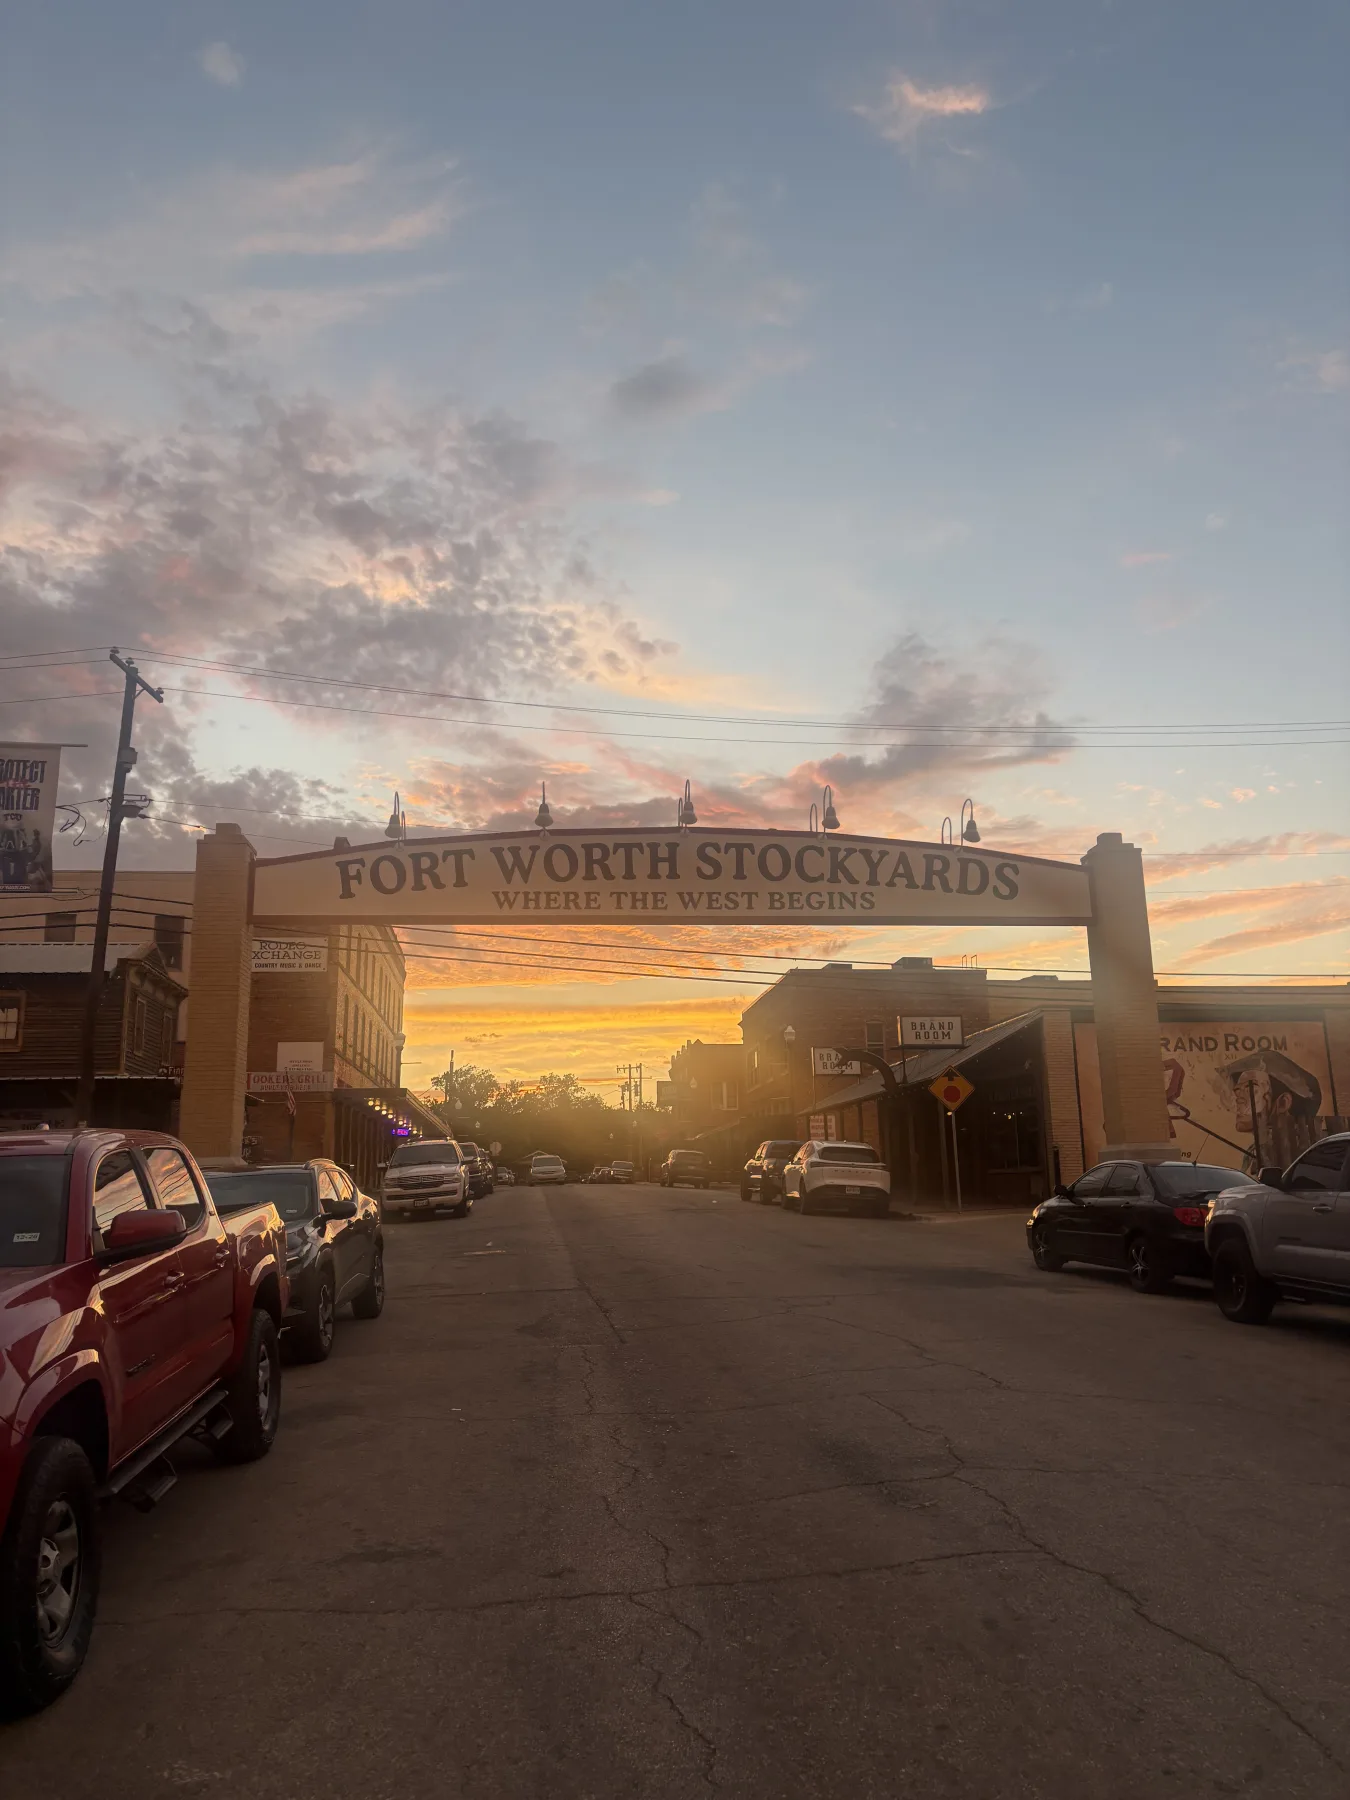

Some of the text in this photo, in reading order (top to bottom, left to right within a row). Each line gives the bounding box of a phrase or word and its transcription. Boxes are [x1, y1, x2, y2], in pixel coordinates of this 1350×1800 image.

[3, 813, 23, 821] TCU
[335, 842, 1020, 901] FORT WORTH STOCKYARDS
[492, 890, 876, 910] WHERE THE WEST BEGINS
[260, 941, 307, 950] RODEO
[252, 951, 321, 960] XCHANGE
[911, 1021, 954, 1030] BRAND
[915, 1031, 951, 1039] ROOM
[1160, 1036, 1219, 1052] RAND
[1223, 1033, 1288, 1051] ROOM
[298, 1074, 328, 1084] GRILL
